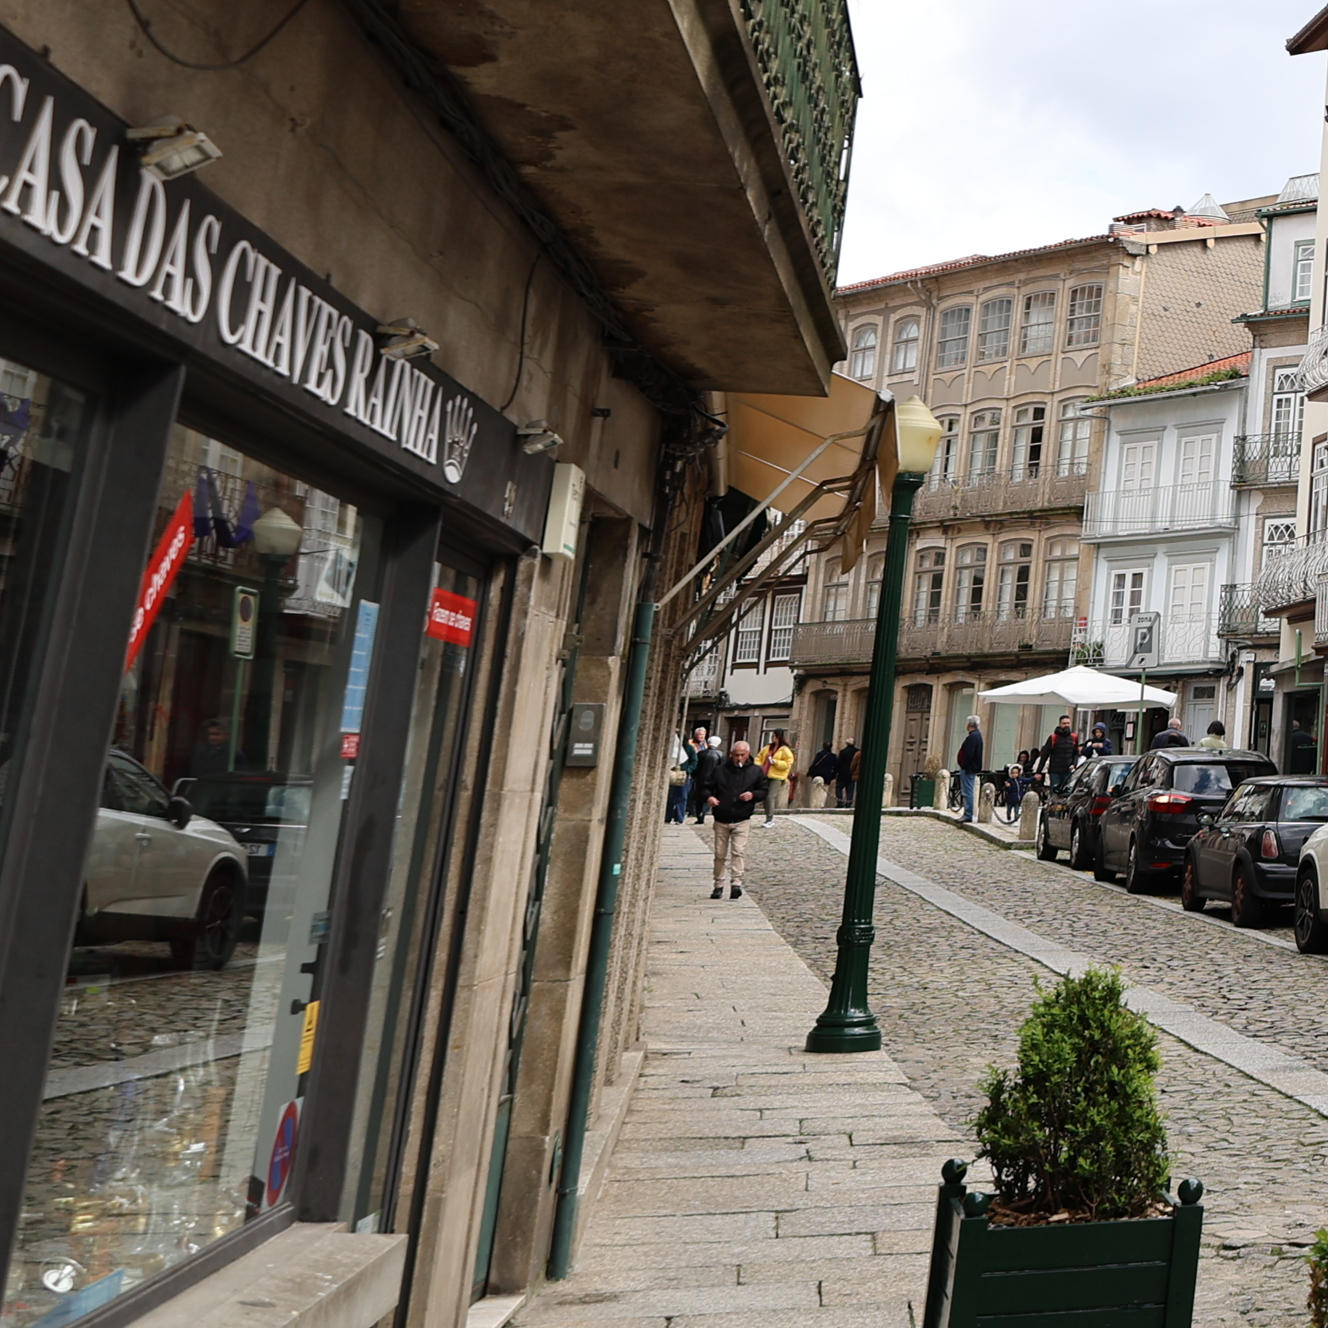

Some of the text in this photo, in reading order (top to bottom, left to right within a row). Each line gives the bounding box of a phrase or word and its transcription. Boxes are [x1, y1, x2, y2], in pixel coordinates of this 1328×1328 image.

[116, 166, 222, 323] DAS
[217, 239, 353, 406] CHAVES
[343, 329, 443, 465] RAINHA
